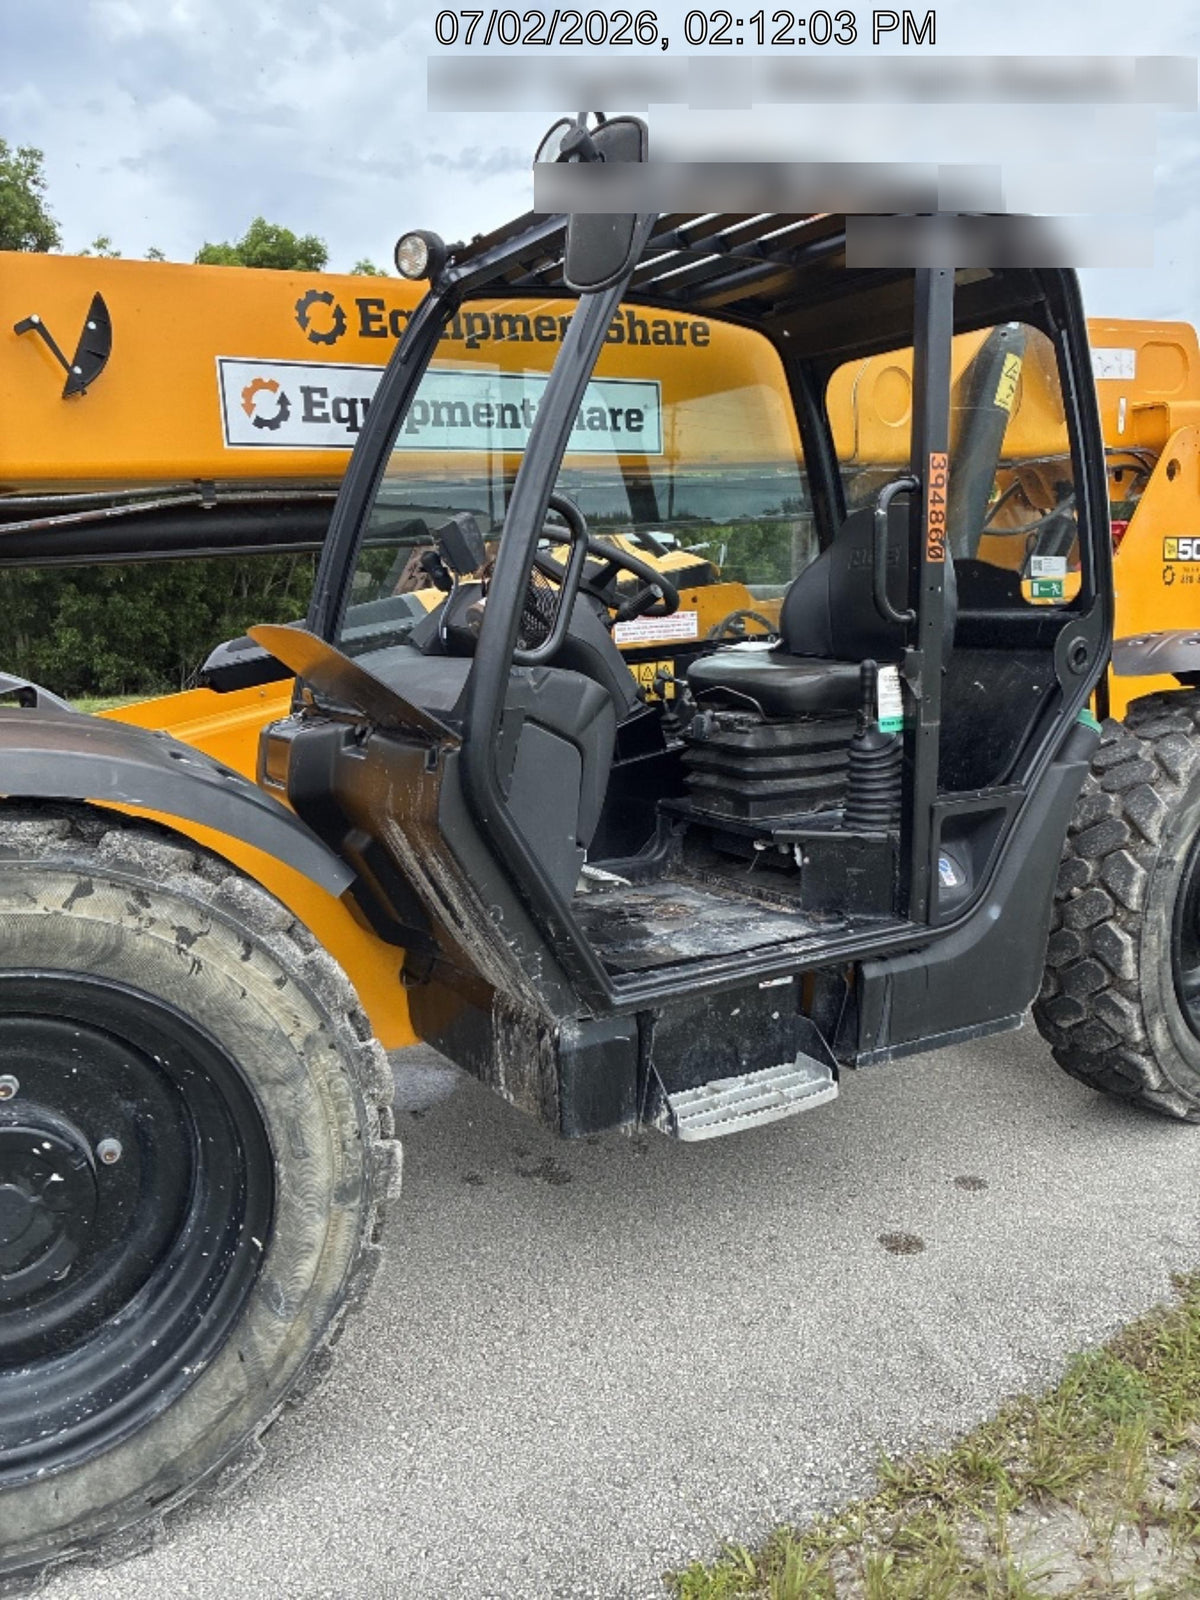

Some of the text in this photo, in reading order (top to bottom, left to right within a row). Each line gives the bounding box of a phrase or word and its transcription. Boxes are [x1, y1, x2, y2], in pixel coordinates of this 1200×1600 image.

[355, 298, 710, 348] EipmeShare
[300, 385, 645, 434] Eqpmentare
[928, 456, 947, 559] 394860
